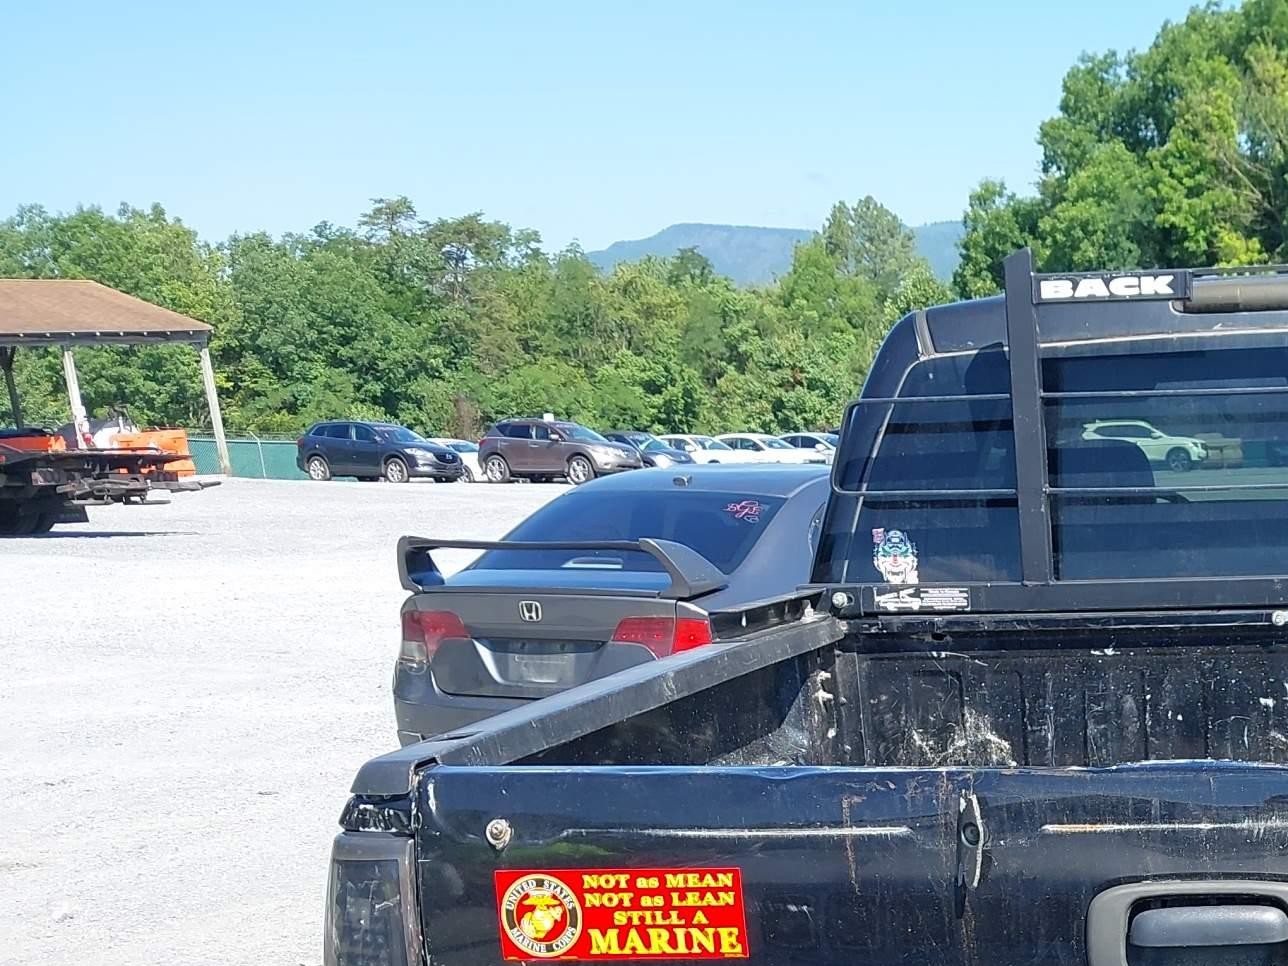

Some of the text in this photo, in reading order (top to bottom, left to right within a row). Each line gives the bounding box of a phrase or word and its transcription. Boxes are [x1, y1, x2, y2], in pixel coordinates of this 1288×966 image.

[1040, 275, 1175, 299] BACK
[582, 873, 734, 889] NOT as MEAN
[506, 879, 575, 910] UNITED STATES
[584, 891, 735, 908] NOT as LEAN
[613, 910, 709, 925] STILL A
[510, 926, 576, 953] MARINE CORPS
[588, 927, 743, 955] MARINE
